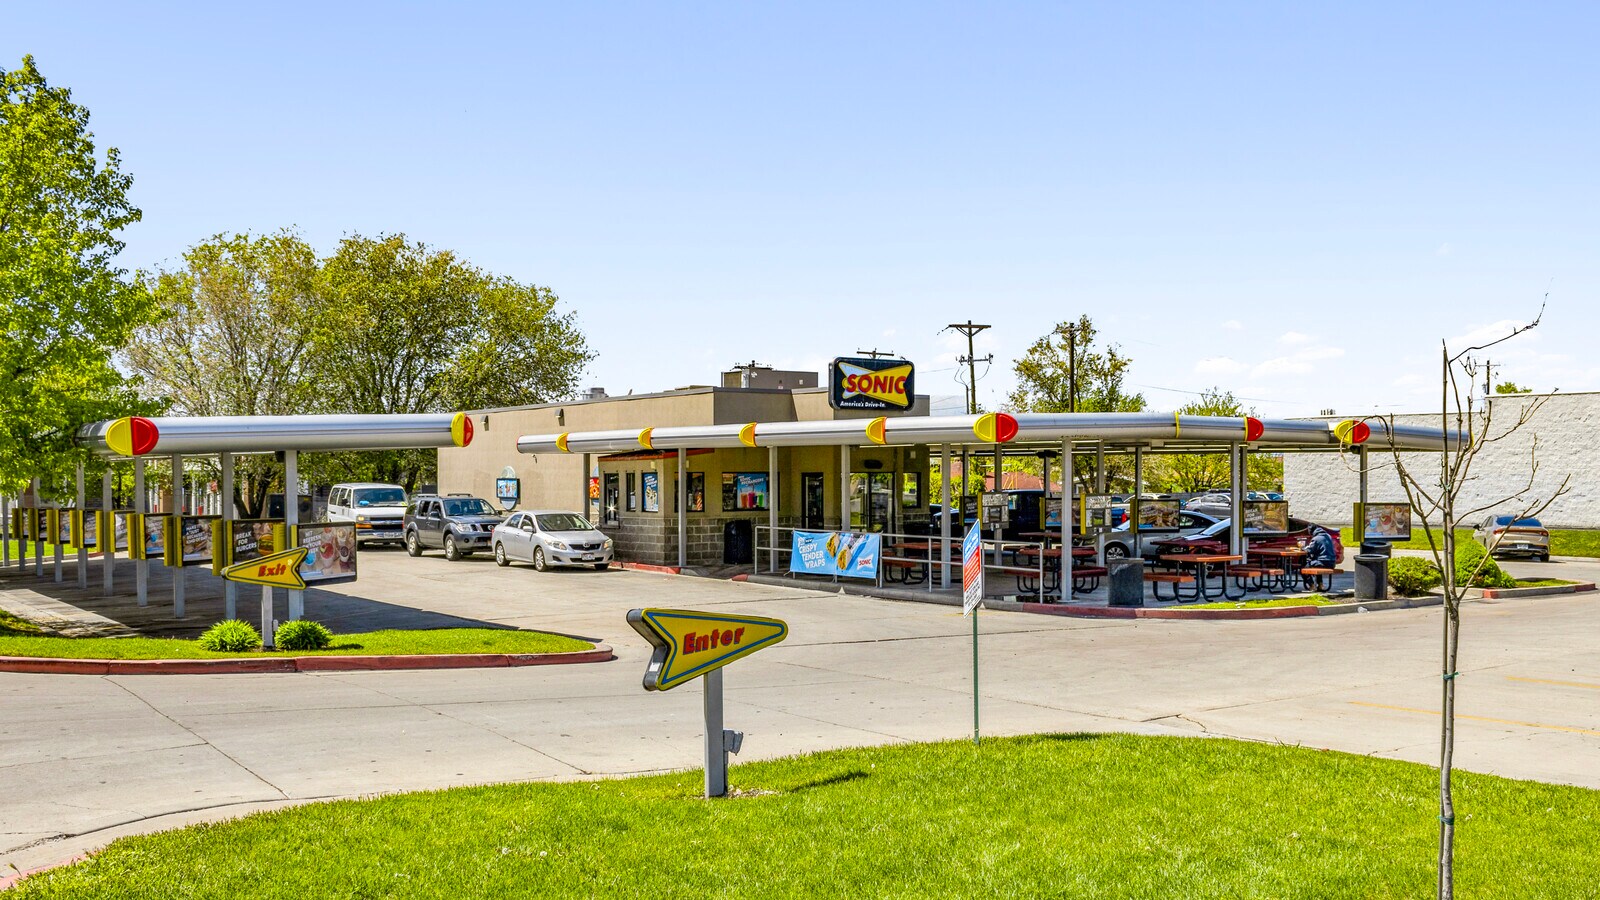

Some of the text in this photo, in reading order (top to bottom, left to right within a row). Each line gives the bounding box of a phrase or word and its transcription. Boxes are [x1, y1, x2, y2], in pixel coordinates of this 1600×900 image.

[846, 374, 907, 394] SONIC
[236, 531, 252, 540] BREAK
[236, 542, 257, 553] BURGERS
[800, 543, 818, 554] CRISPY
[802, 551, 824, 561] TENDER
[804, 559, 826, 569] WRAPS
[858, 558, 872, 566] SONIC
[258, 563, 287, 577] Exit
[683, 626, 745, 655] Enter
